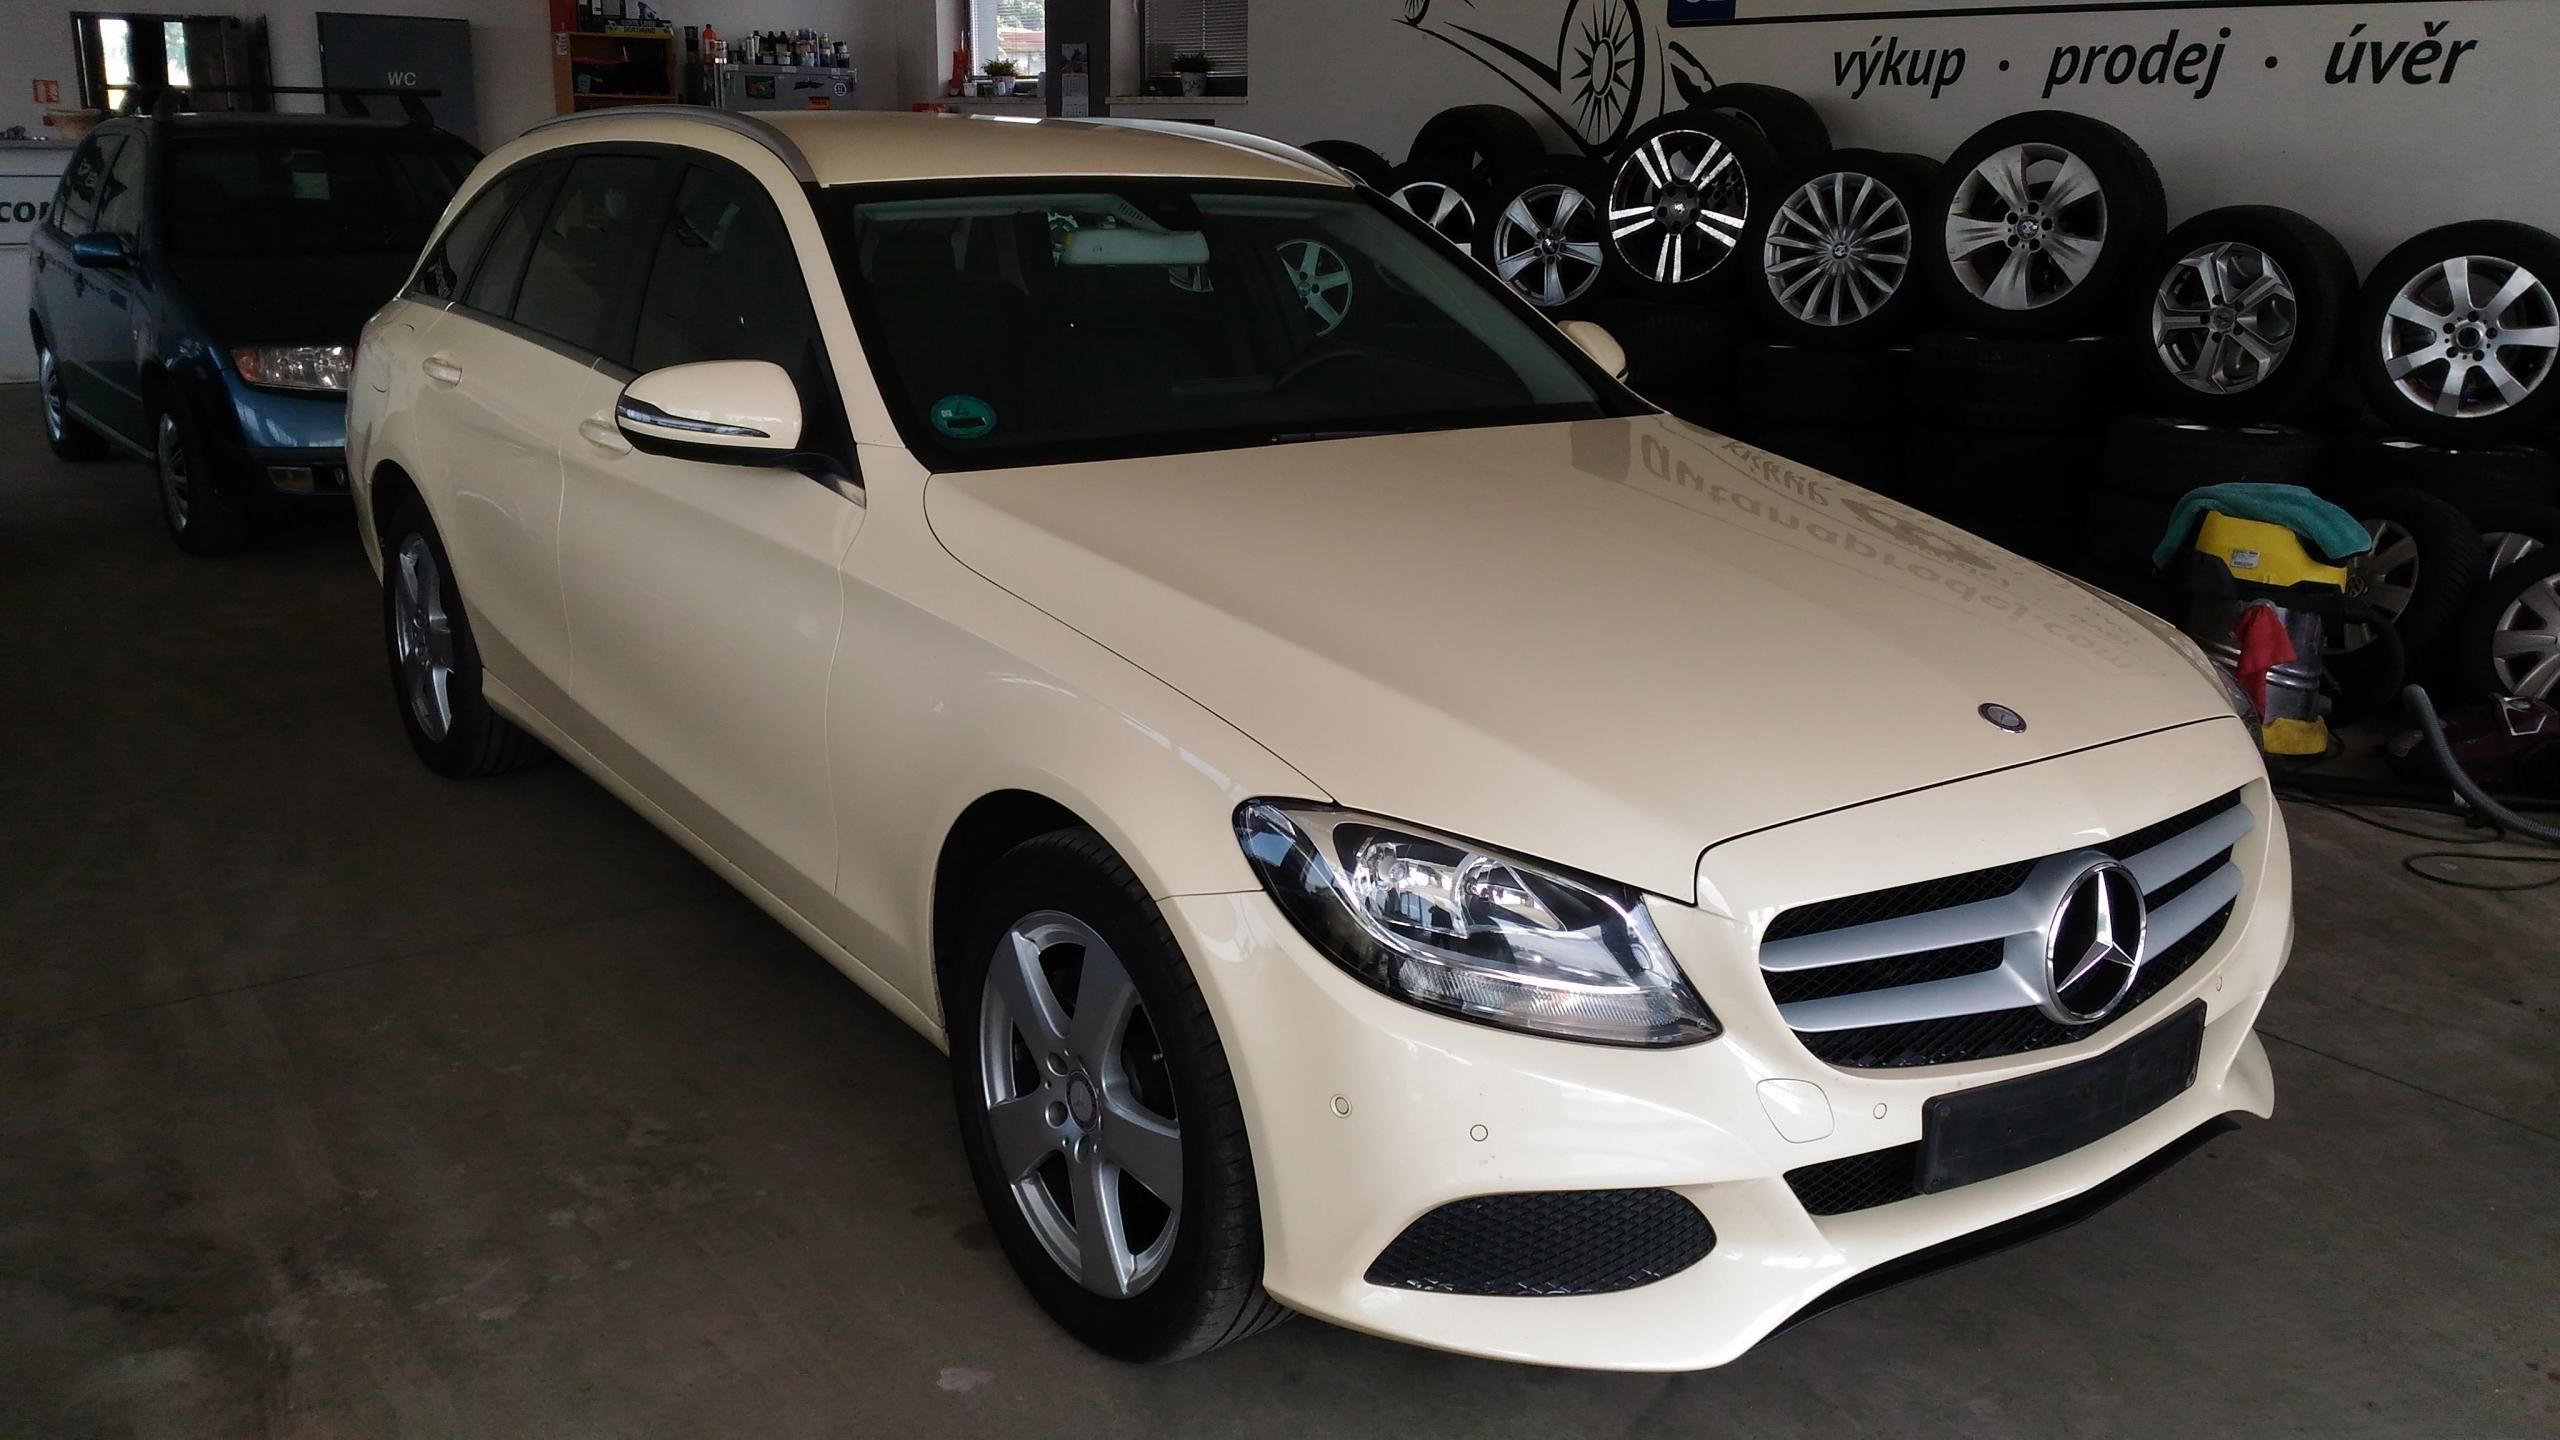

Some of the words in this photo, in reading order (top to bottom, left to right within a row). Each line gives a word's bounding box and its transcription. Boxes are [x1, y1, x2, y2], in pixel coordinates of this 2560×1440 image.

[388, 71, 416, 87] WC
[1833, 35, 1966, 100] výkup
[2041, 26, 2232, 100] prodej
[2324, 20, 2478, 85] úvěr
